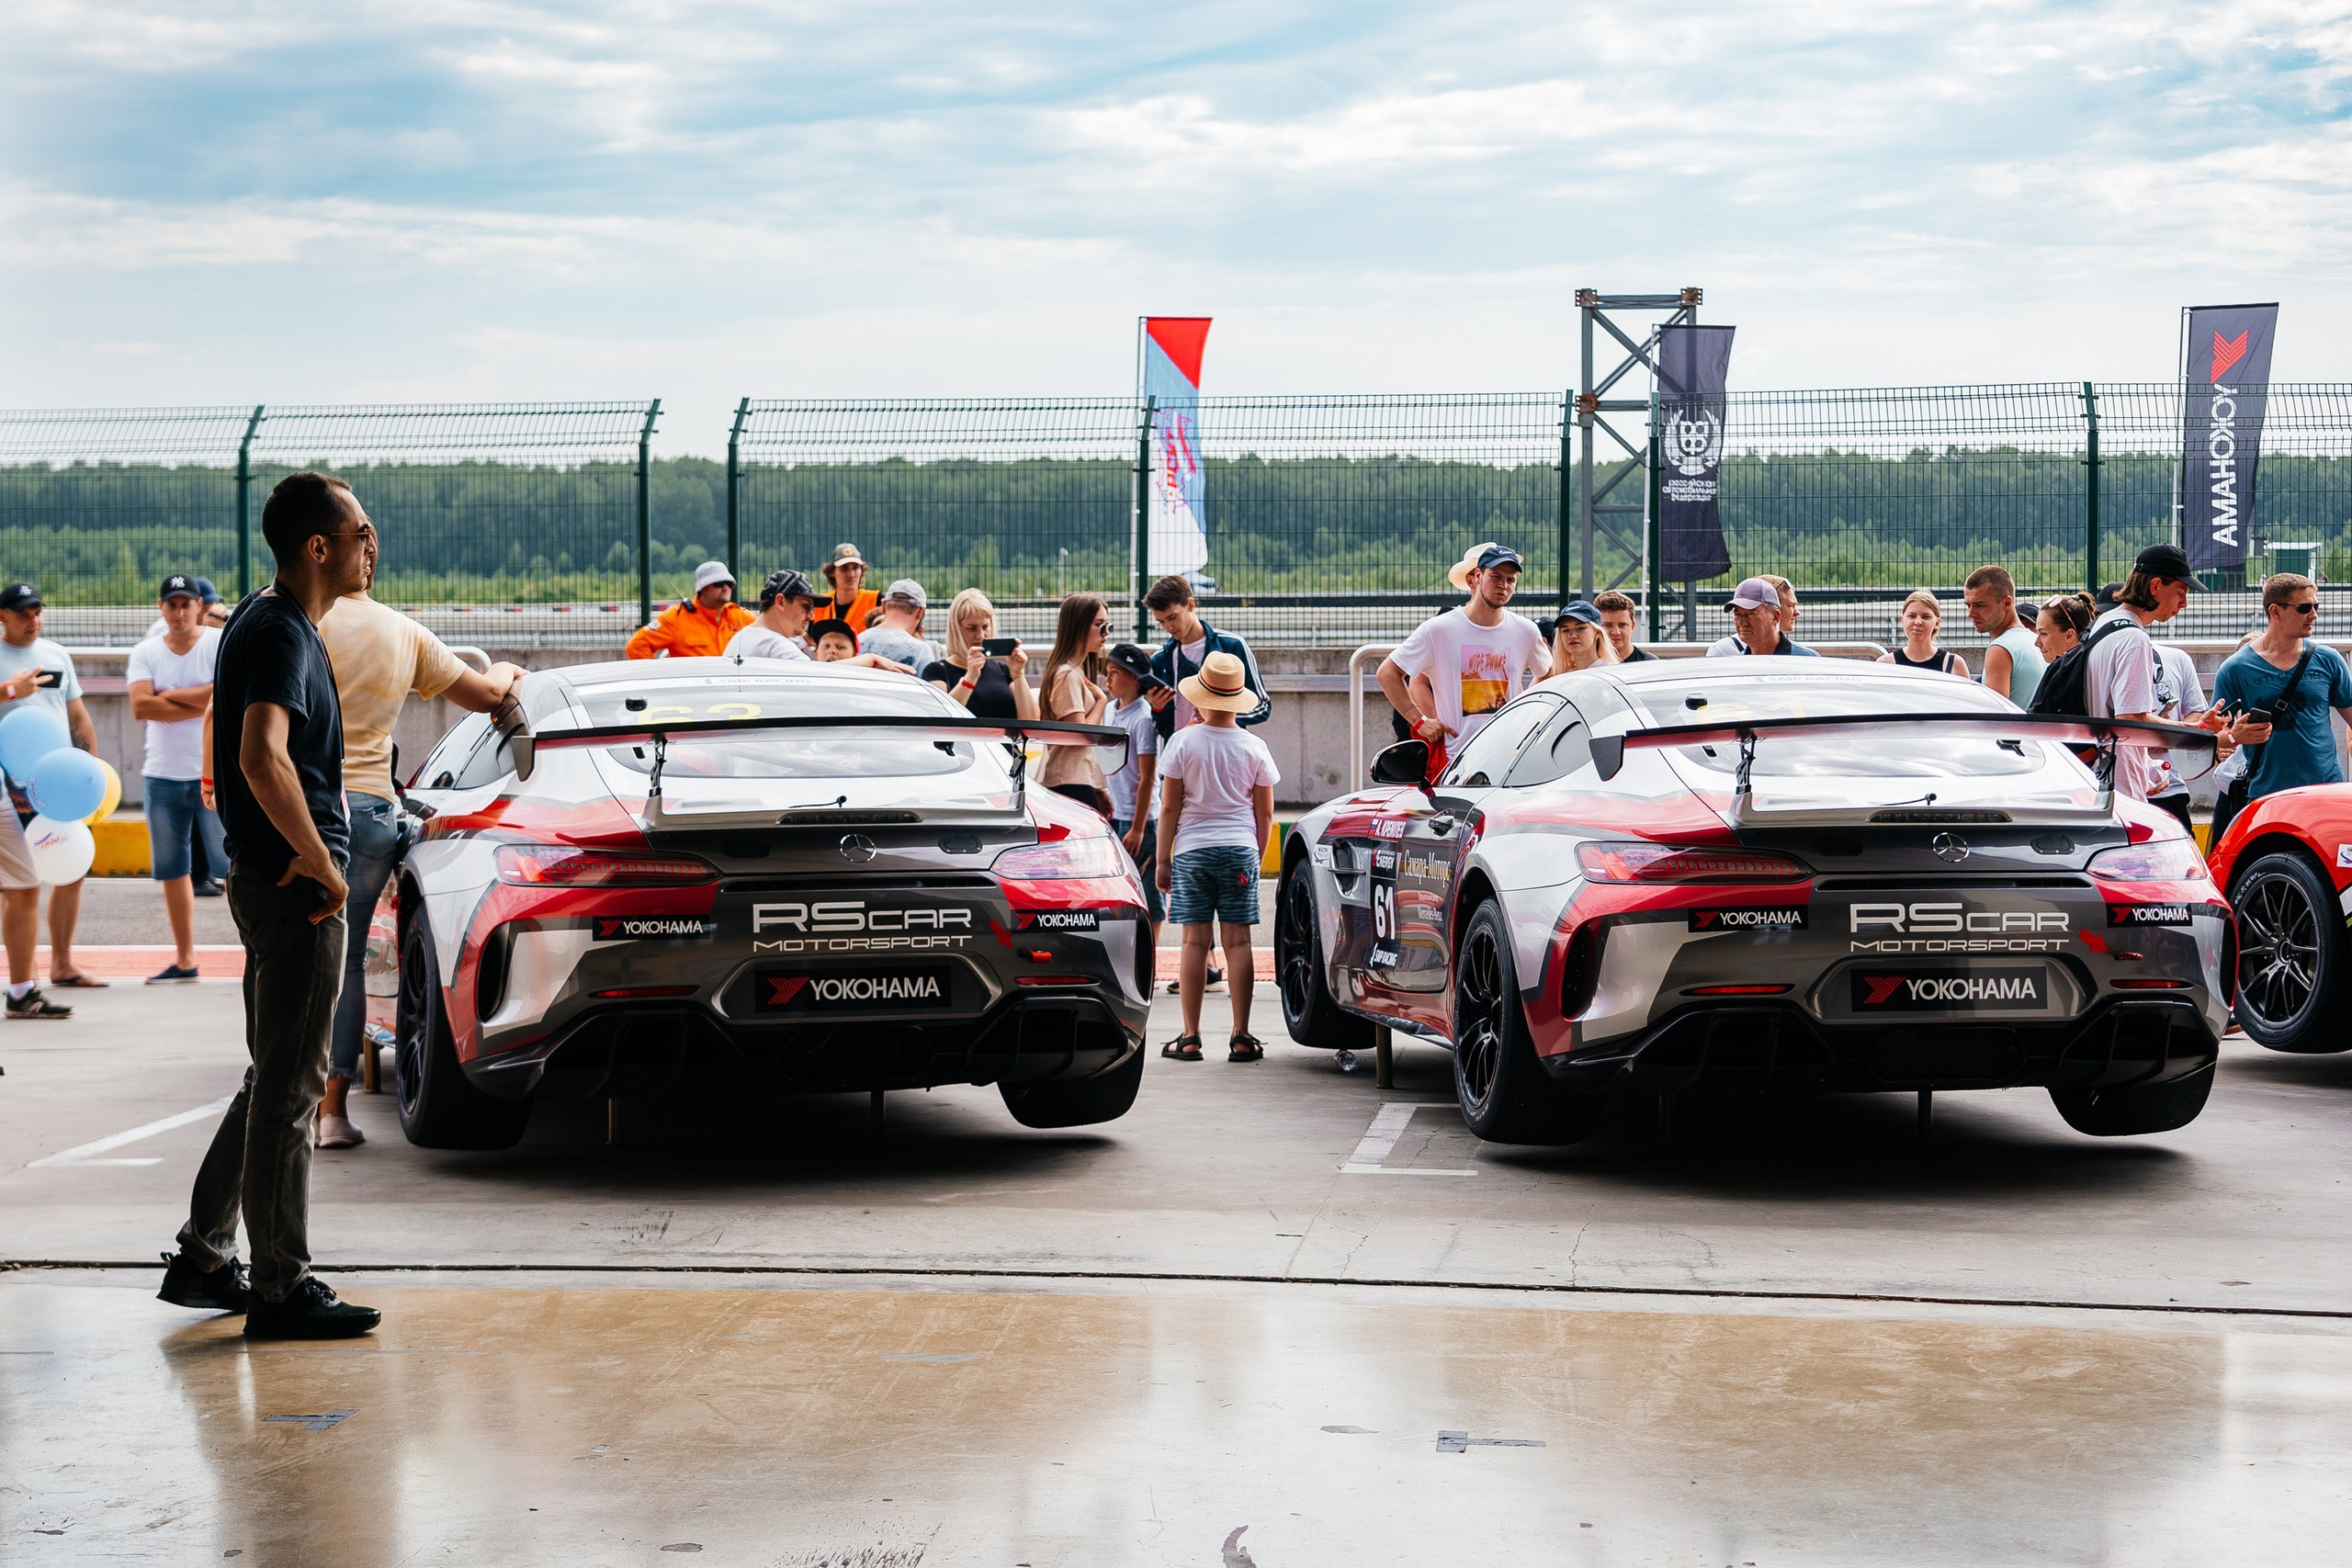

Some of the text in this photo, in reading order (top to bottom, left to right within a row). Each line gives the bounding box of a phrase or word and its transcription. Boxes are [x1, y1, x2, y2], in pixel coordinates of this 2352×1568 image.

[2253, 674, 2275, 685] am
[1374, 884, 1396, 941] 61
[1719, 910, 1802, 925] YOKOHAMA
[2132, 908, 2189, 921] YOKOHAMA
[623, 920, 704, 934] YOKOHAMA
[1036, 913, 1096, 928] YOKOHAMA
[753, 935, 973, 953] MOTORSPORT
[1850, 939, 2070, 953] MOTORSPORT
[809, 976, 941, 1000] YOKOHAMA
[1906, 977, 2038, 1000] YOKOHAMA
